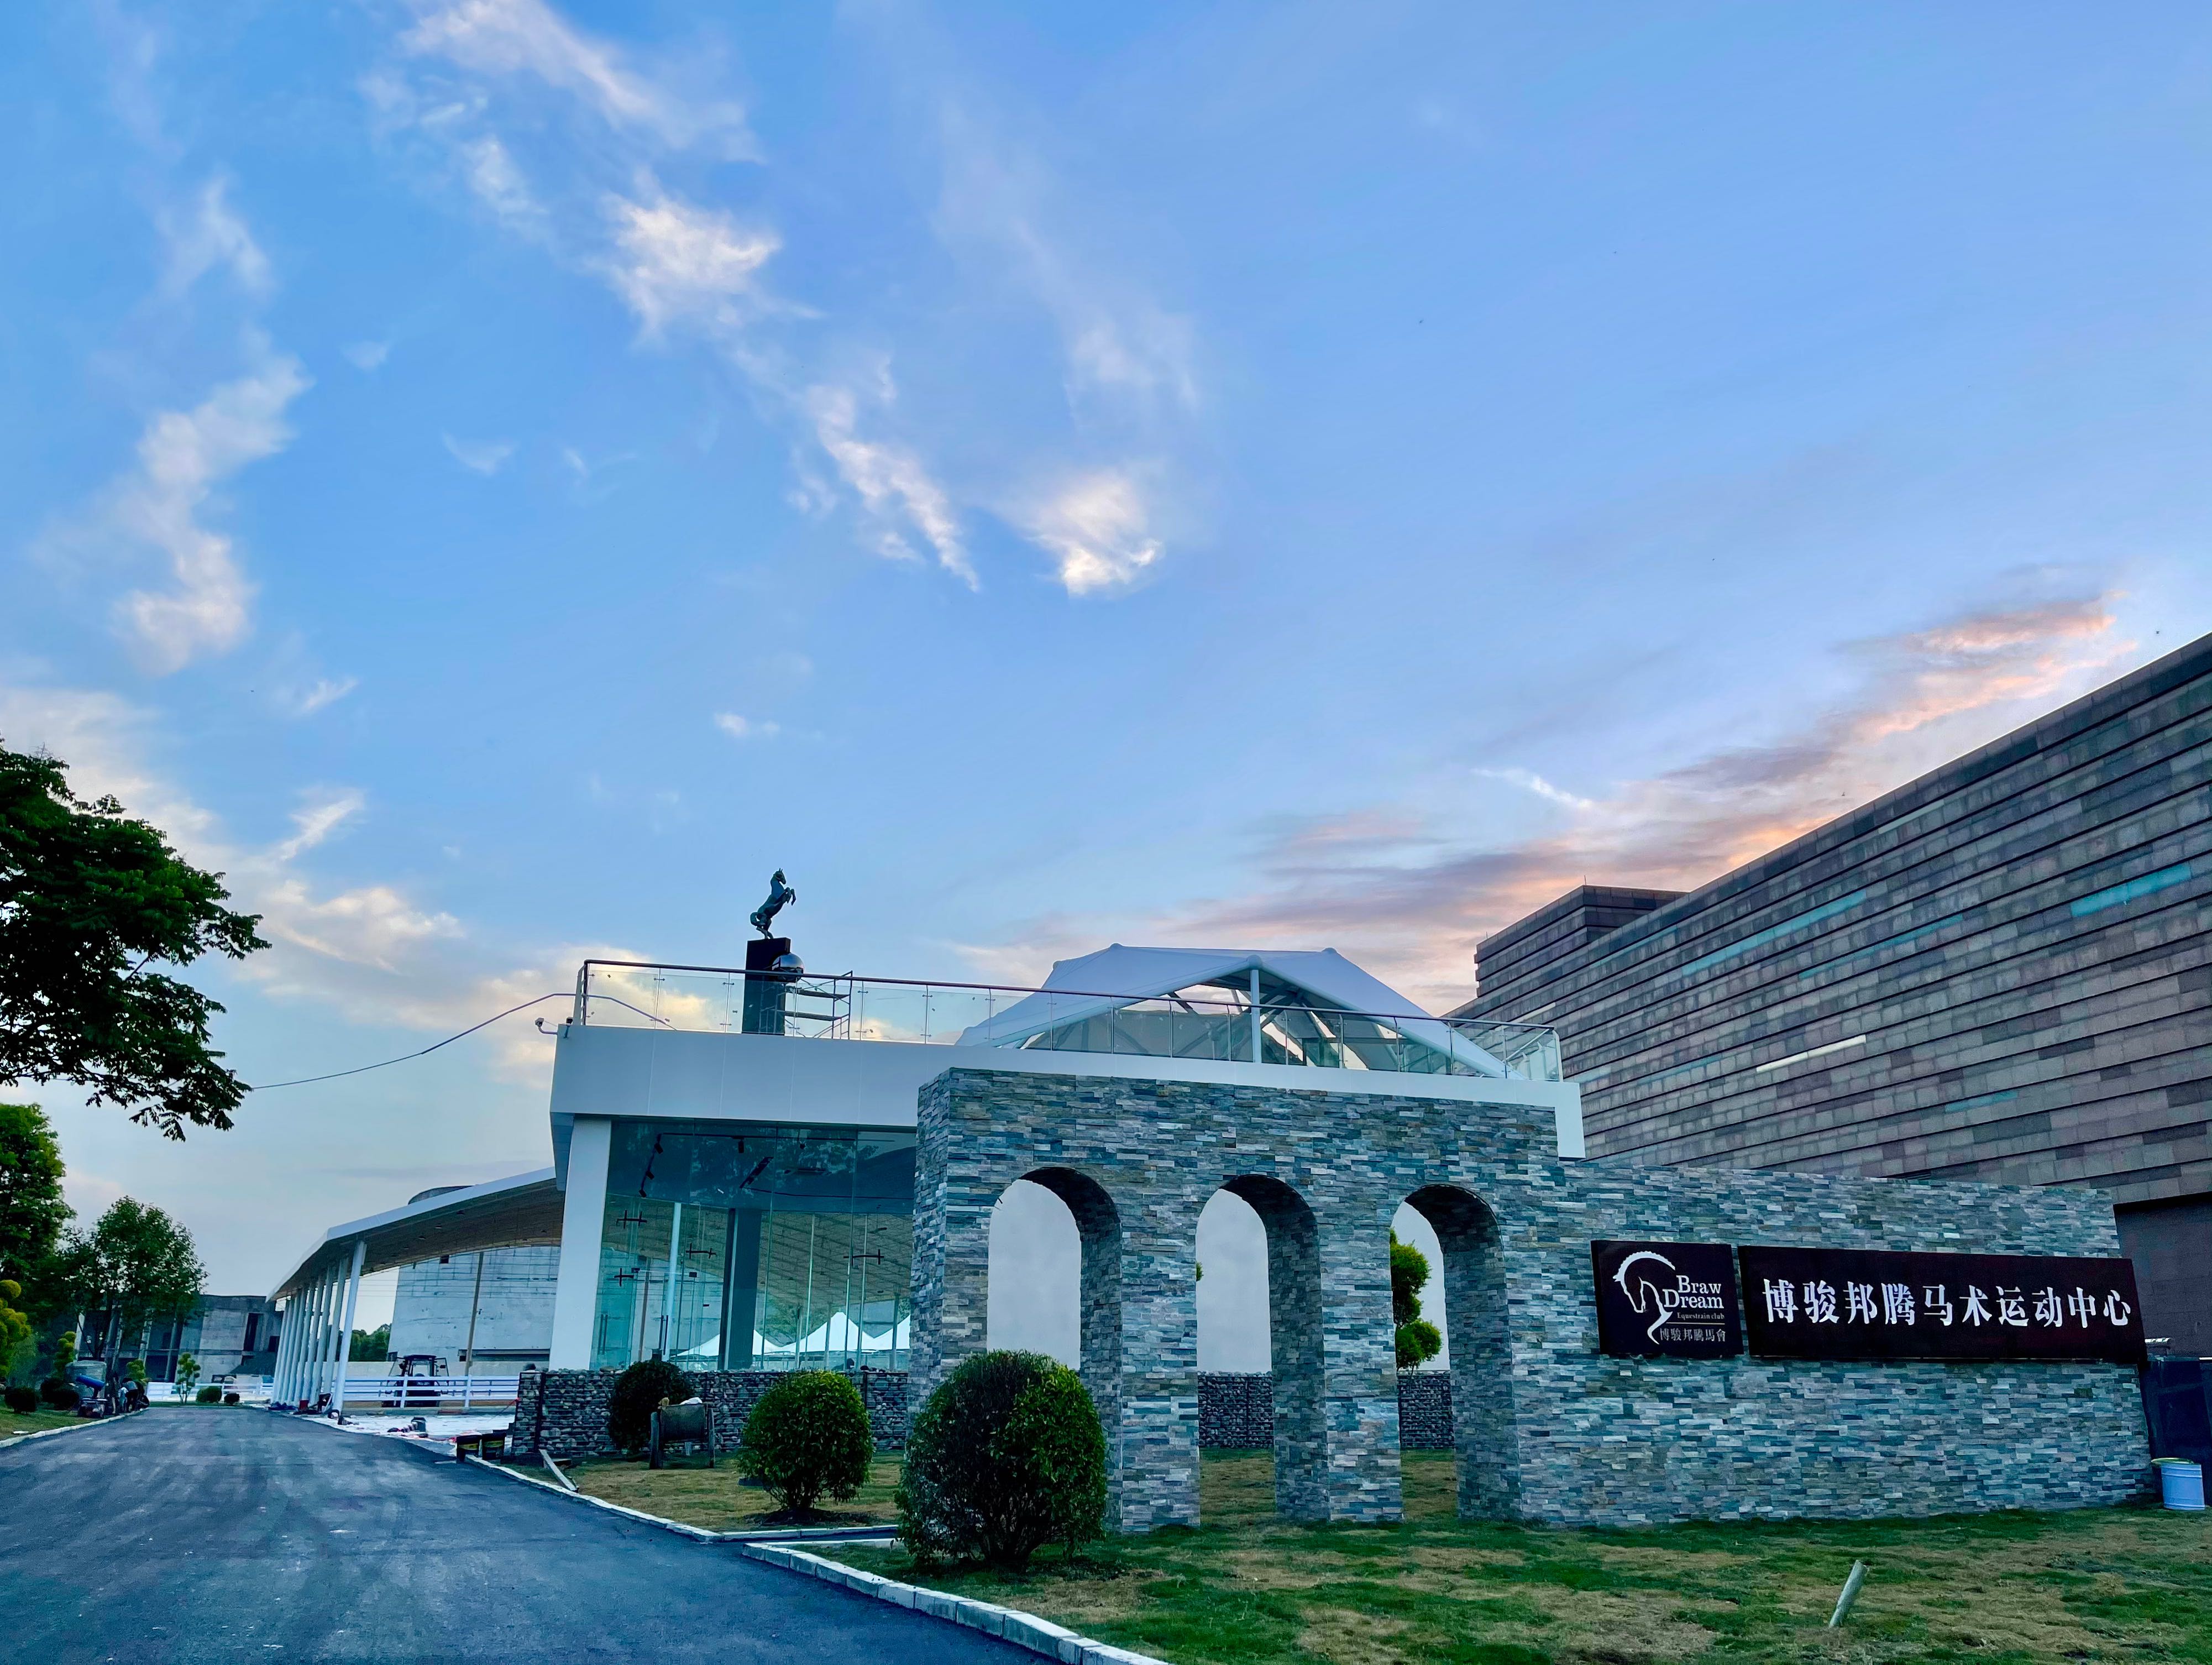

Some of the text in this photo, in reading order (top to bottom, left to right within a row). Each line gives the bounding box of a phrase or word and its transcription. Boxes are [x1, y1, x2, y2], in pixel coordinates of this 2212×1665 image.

[1676, 1275, 1722, 1294] Braw
[1662, 1289, 1724, 1309] Dream
[1762, 1278, 2131, 1328] 博骏邦腾马术运动中心
